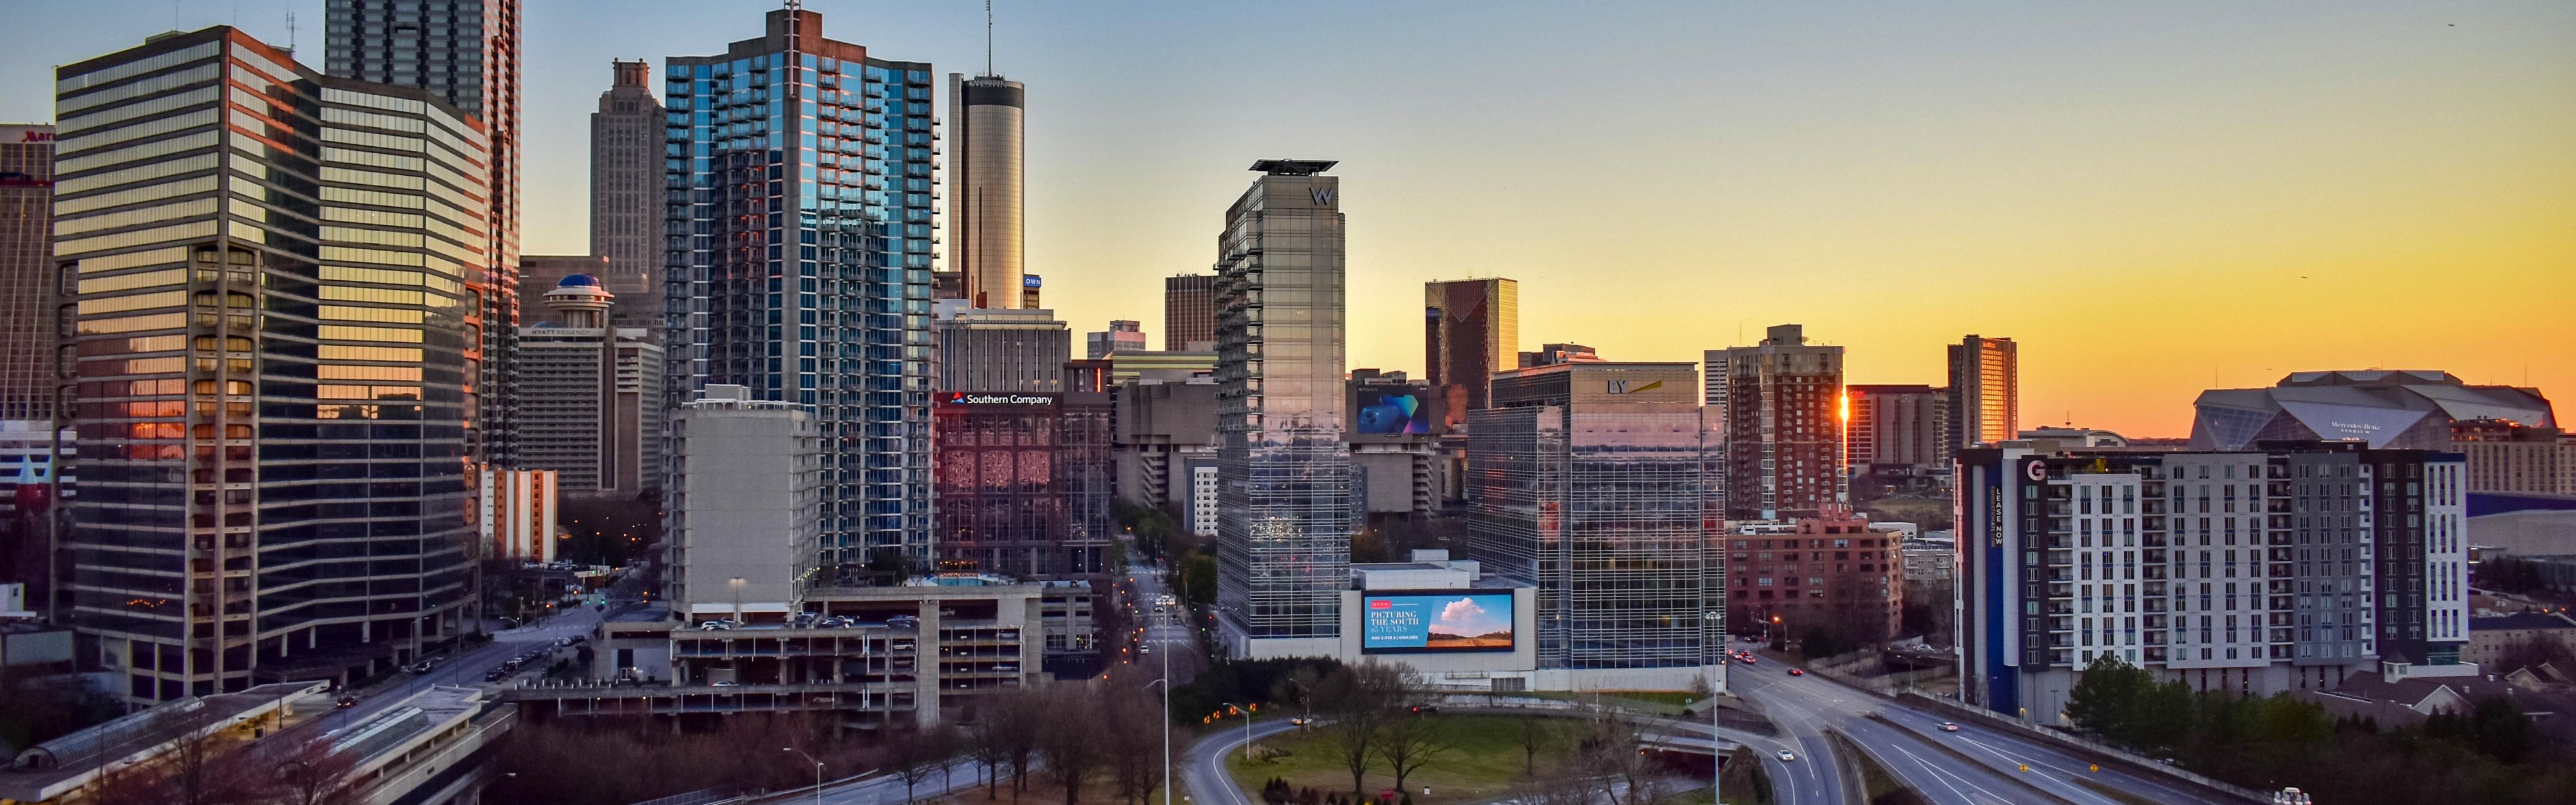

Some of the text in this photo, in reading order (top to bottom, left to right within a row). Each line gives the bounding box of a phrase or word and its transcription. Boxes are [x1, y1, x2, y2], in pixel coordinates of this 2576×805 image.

[969, 79, 1007, 88] WESTIN
[1309, 187, 1334, 206] W
[1607, 380, 1628, 394] EY
[967, 394, 1052, 405] Southern Company
[2331, 421, 2381, 430] Mercedes-Benz
[2027, 460, 2045, 481] G
